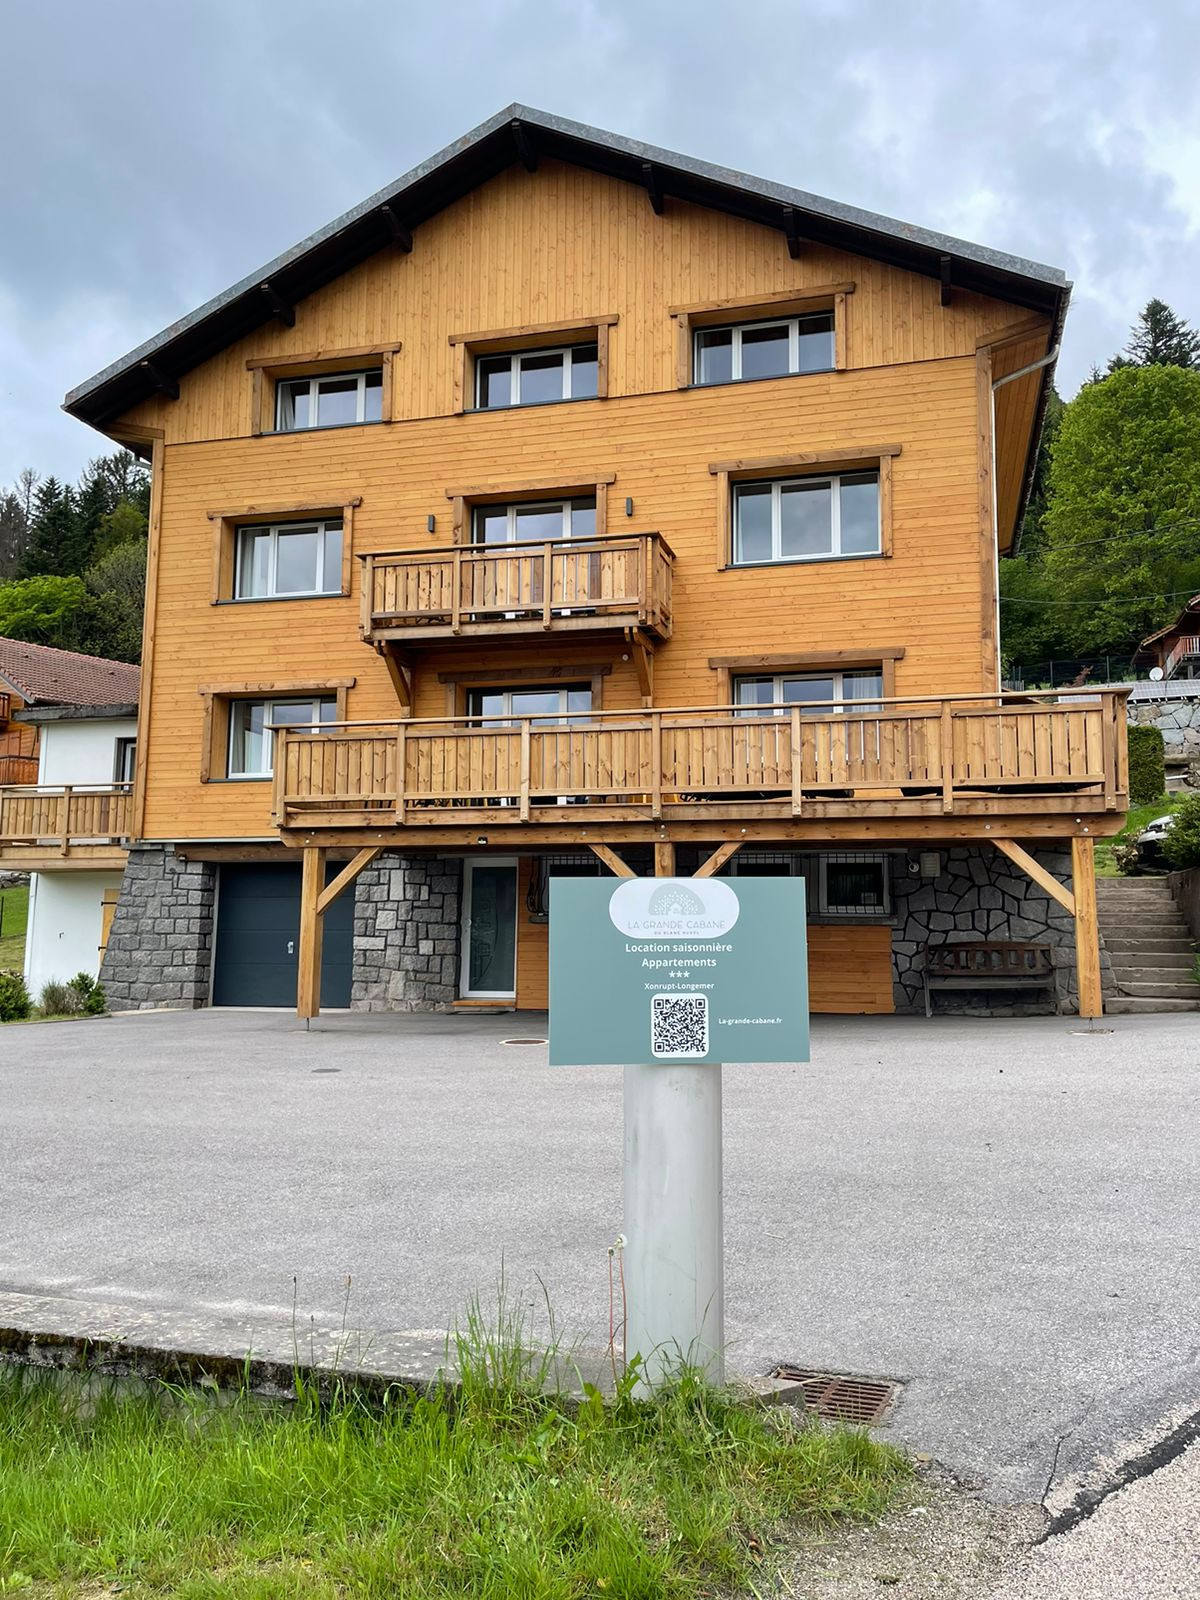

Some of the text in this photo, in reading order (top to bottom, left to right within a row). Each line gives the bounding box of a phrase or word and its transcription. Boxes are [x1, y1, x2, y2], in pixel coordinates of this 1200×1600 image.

[627, 920, 726, 929] LA GRANDE CABANE
[625, 942, 733, 952] Location saisonnière
[641, 958, 717, 969] Appartements
[644, 983, 714, 991] Xonrupt-Longemer
[718, 1017, 783, 1026] La-grande-cabane.fr
